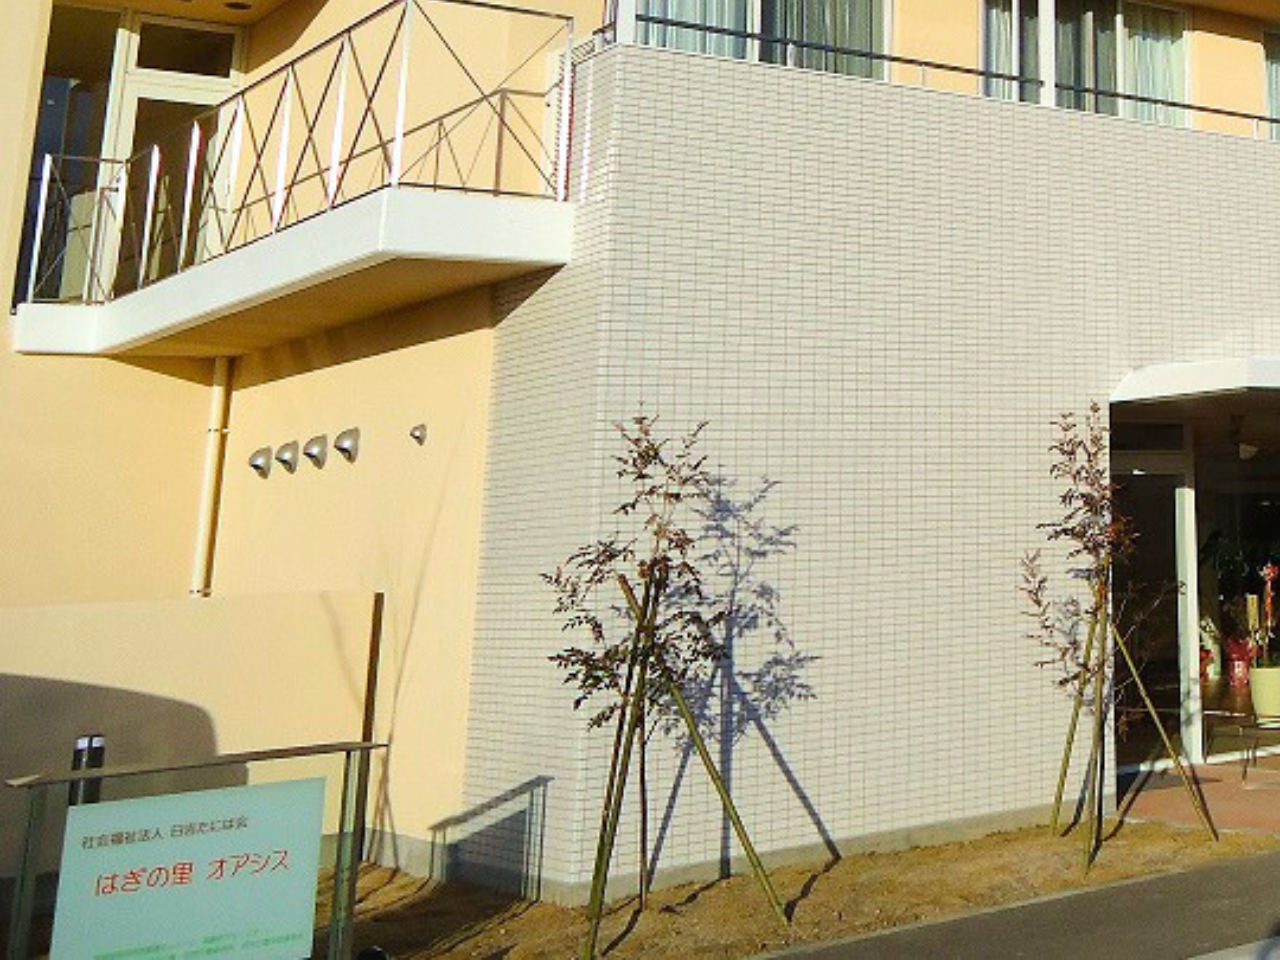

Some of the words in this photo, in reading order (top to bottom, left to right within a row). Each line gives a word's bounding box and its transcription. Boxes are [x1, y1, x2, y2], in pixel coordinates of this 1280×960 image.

[95, 860, 194, 897] はぎの里
[206, 849, 290, 881] オアシス
